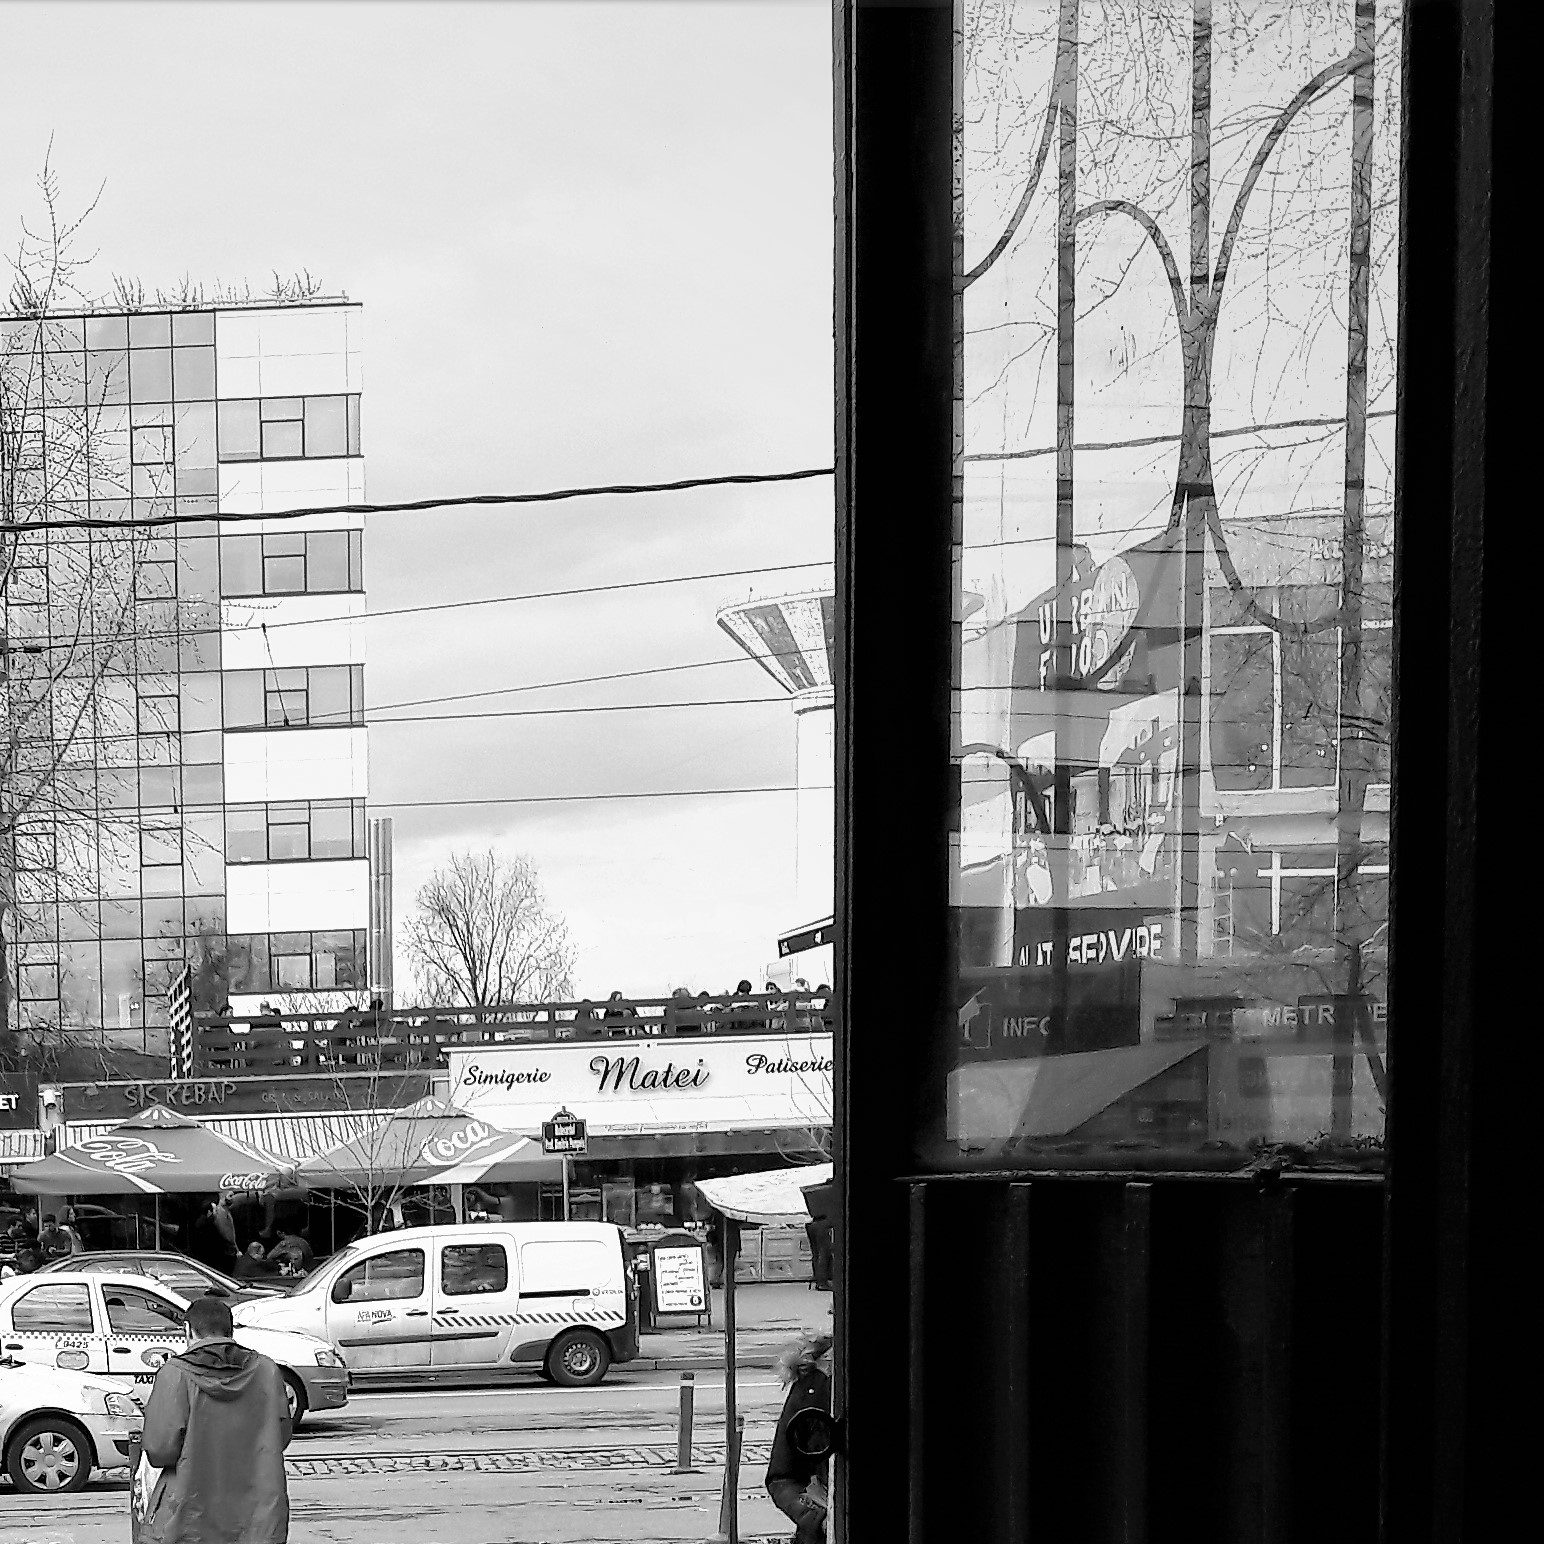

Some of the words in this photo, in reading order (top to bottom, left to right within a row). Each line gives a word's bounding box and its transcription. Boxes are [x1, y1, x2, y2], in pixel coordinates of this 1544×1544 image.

[589, 1055, 710, 1092] Matei
[746, 1054, 833, 1074] Patiserie
[463, 1065, 552, 1091] Simigerie
[166, 1081, 237, 1105] KEBAP
